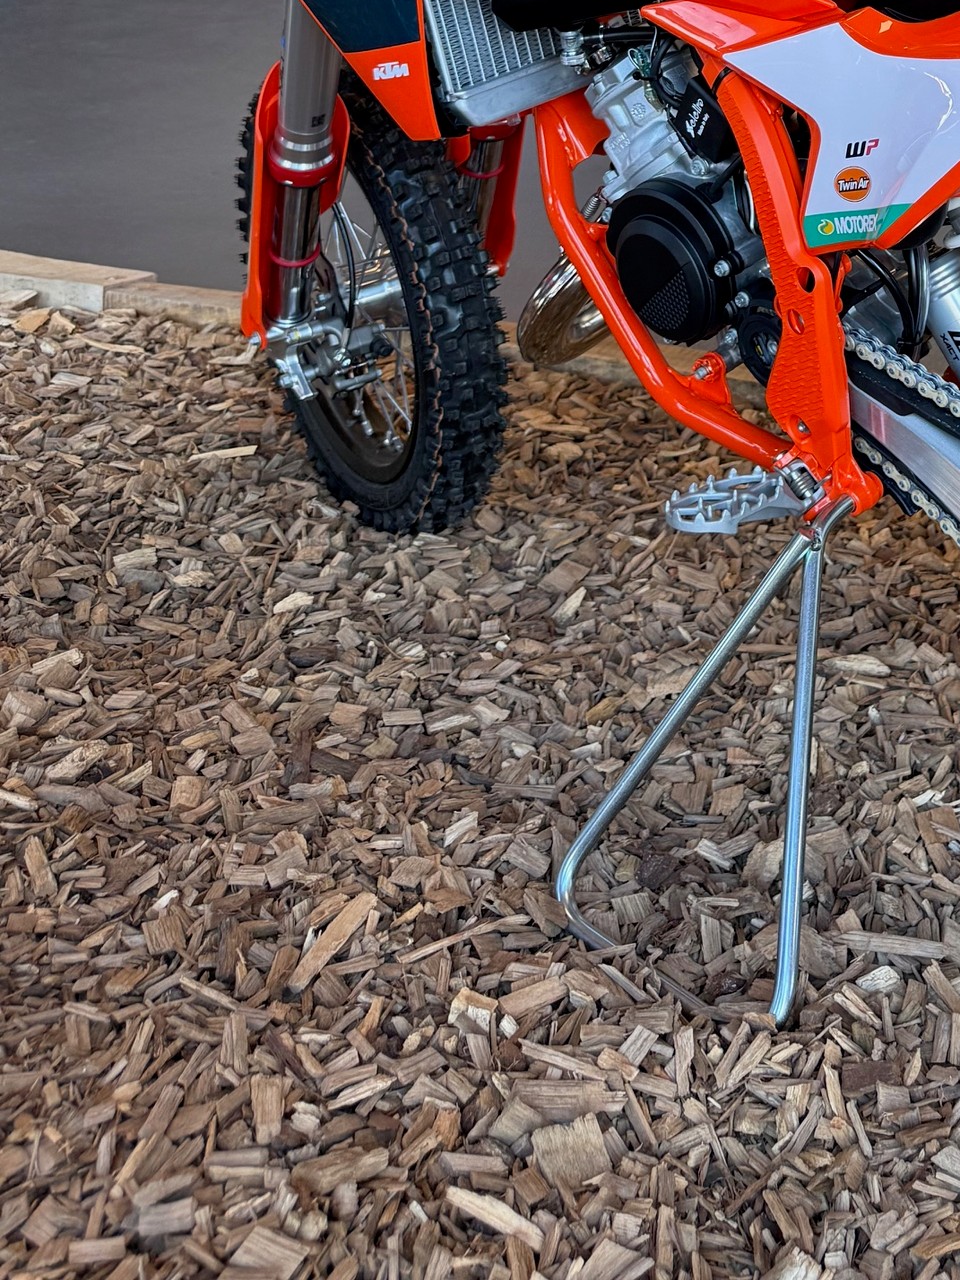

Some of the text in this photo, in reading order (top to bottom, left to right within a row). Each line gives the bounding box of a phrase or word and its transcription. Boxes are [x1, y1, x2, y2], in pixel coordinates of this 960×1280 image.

[372, 61, 410, 81] KTM
[845, 138, 880, 159] WP
[837, 176, 871, 193] Twin Air
[940, 332, 960, 361] XACT
